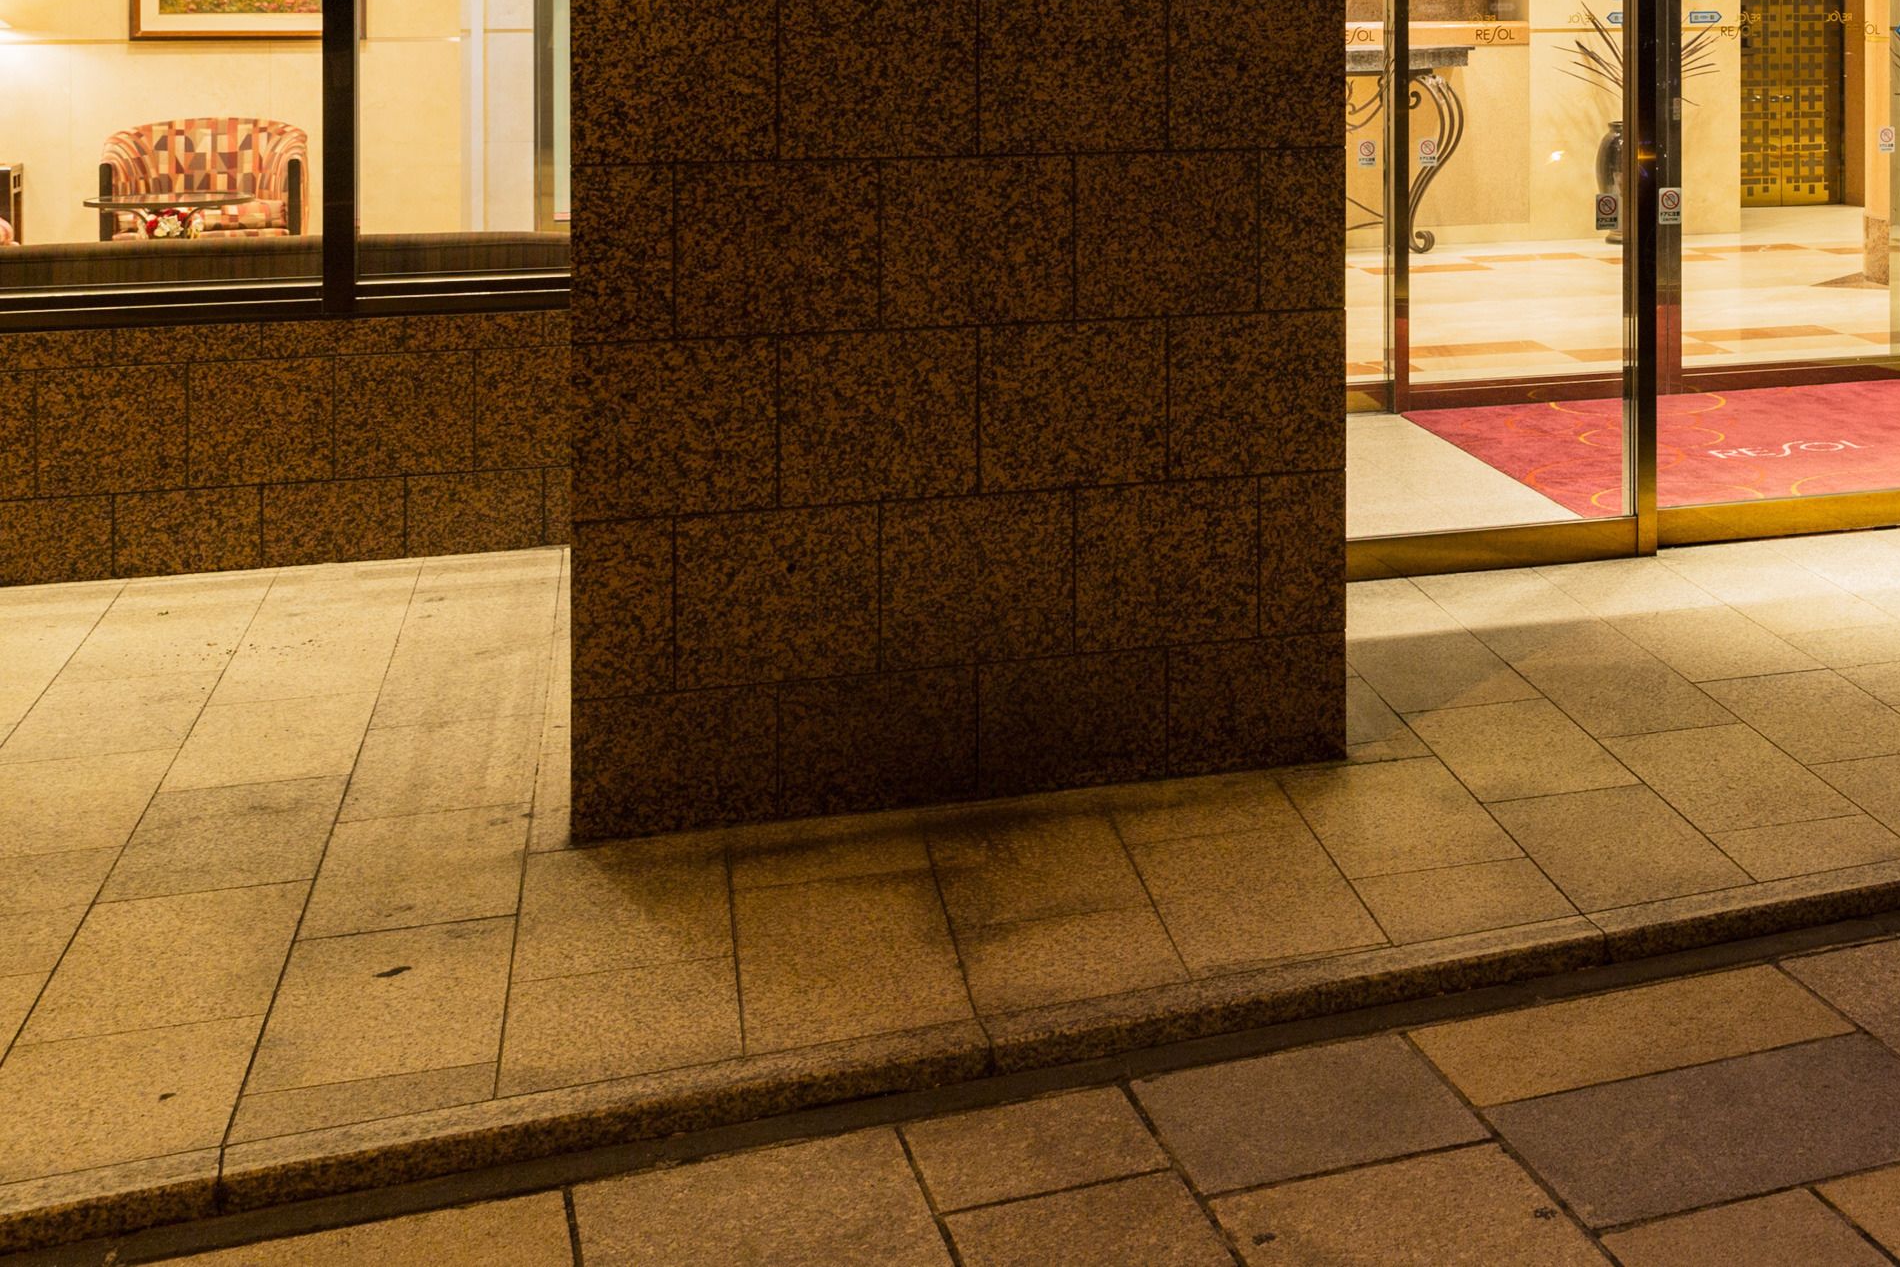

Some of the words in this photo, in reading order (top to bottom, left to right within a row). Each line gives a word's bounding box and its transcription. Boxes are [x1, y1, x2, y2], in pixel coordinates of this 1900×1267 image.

[1345, 26, 1375, 44] SOL
[1475, 25, 1515, 43] RESOL
[1708, 439, 1875, 459] RESOL
